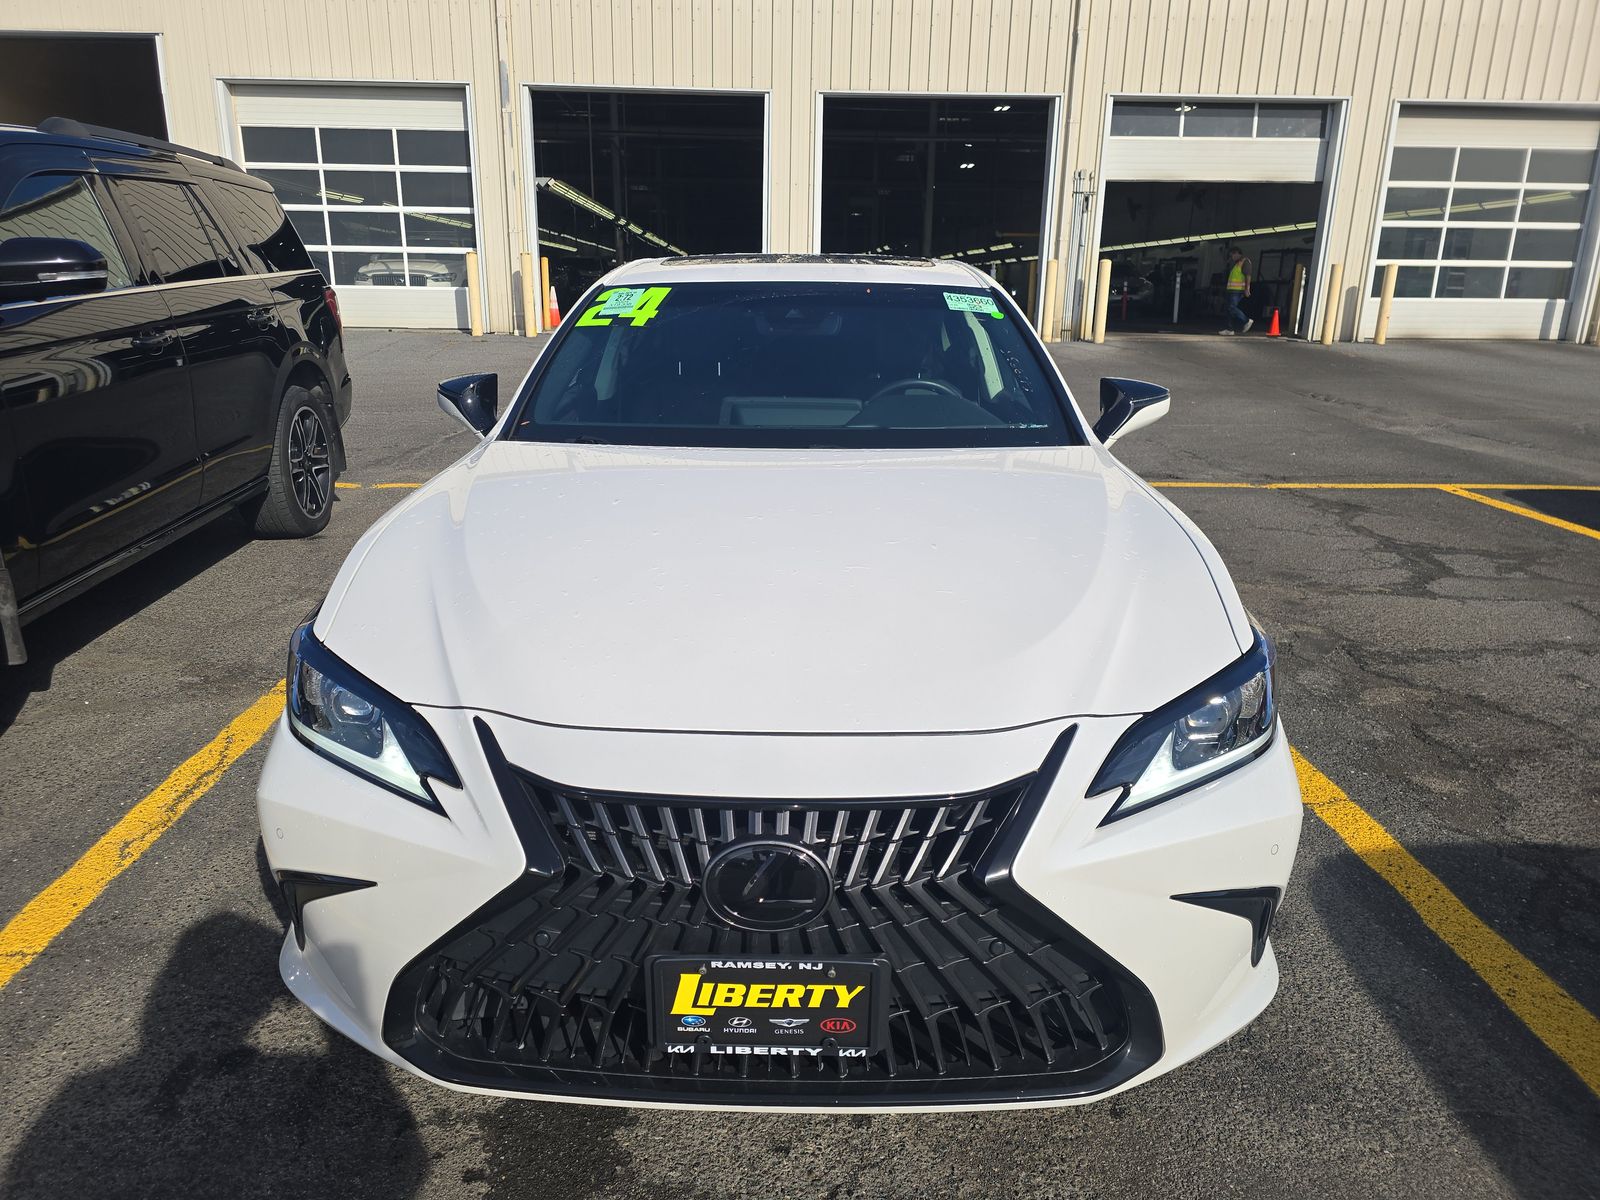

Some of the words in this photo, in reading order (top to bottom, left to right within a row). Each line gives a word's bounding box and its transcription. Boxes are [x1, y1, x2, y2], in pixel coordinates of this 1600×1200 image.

[575, 287, 672, 327] 24
[710, 960, 793, 970] RAMSEY,
[798, 962, 824, 970] NJ
[670, 973, 866, 1016] LIBERTY
[826, 1021, 850, 1030] KIA
[710, 1045, 823, 1057] LIBERTY
